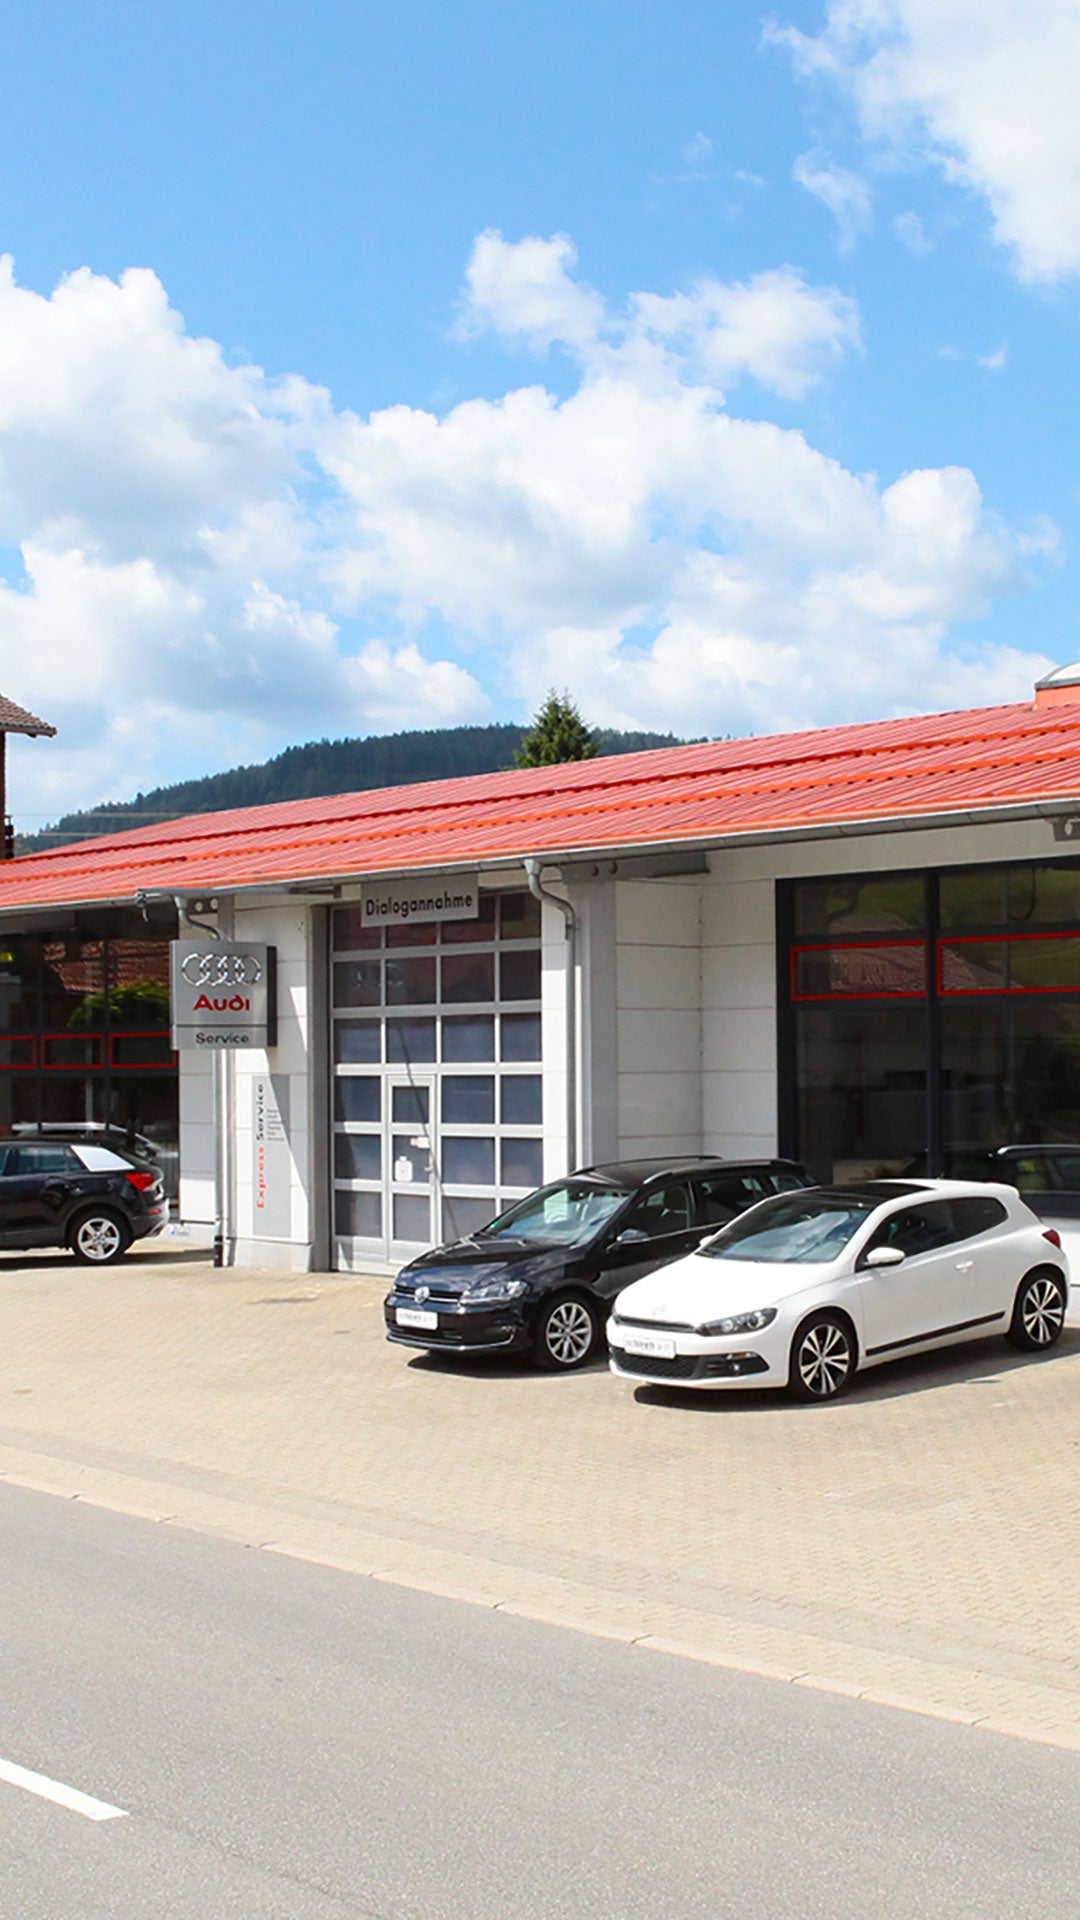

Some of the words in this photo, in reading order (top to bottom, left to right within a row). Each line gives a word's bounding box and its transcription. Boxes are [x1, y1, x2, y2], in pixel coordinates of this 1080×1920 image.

[366, 890, 473, 918] Dialogannahme
[193, 994, 250, 1011] Audi
[196, 1032, 249, 1044] Service
[256, 1084, 264, 1141] Service
[256, 1147, 266, 1209] Express
